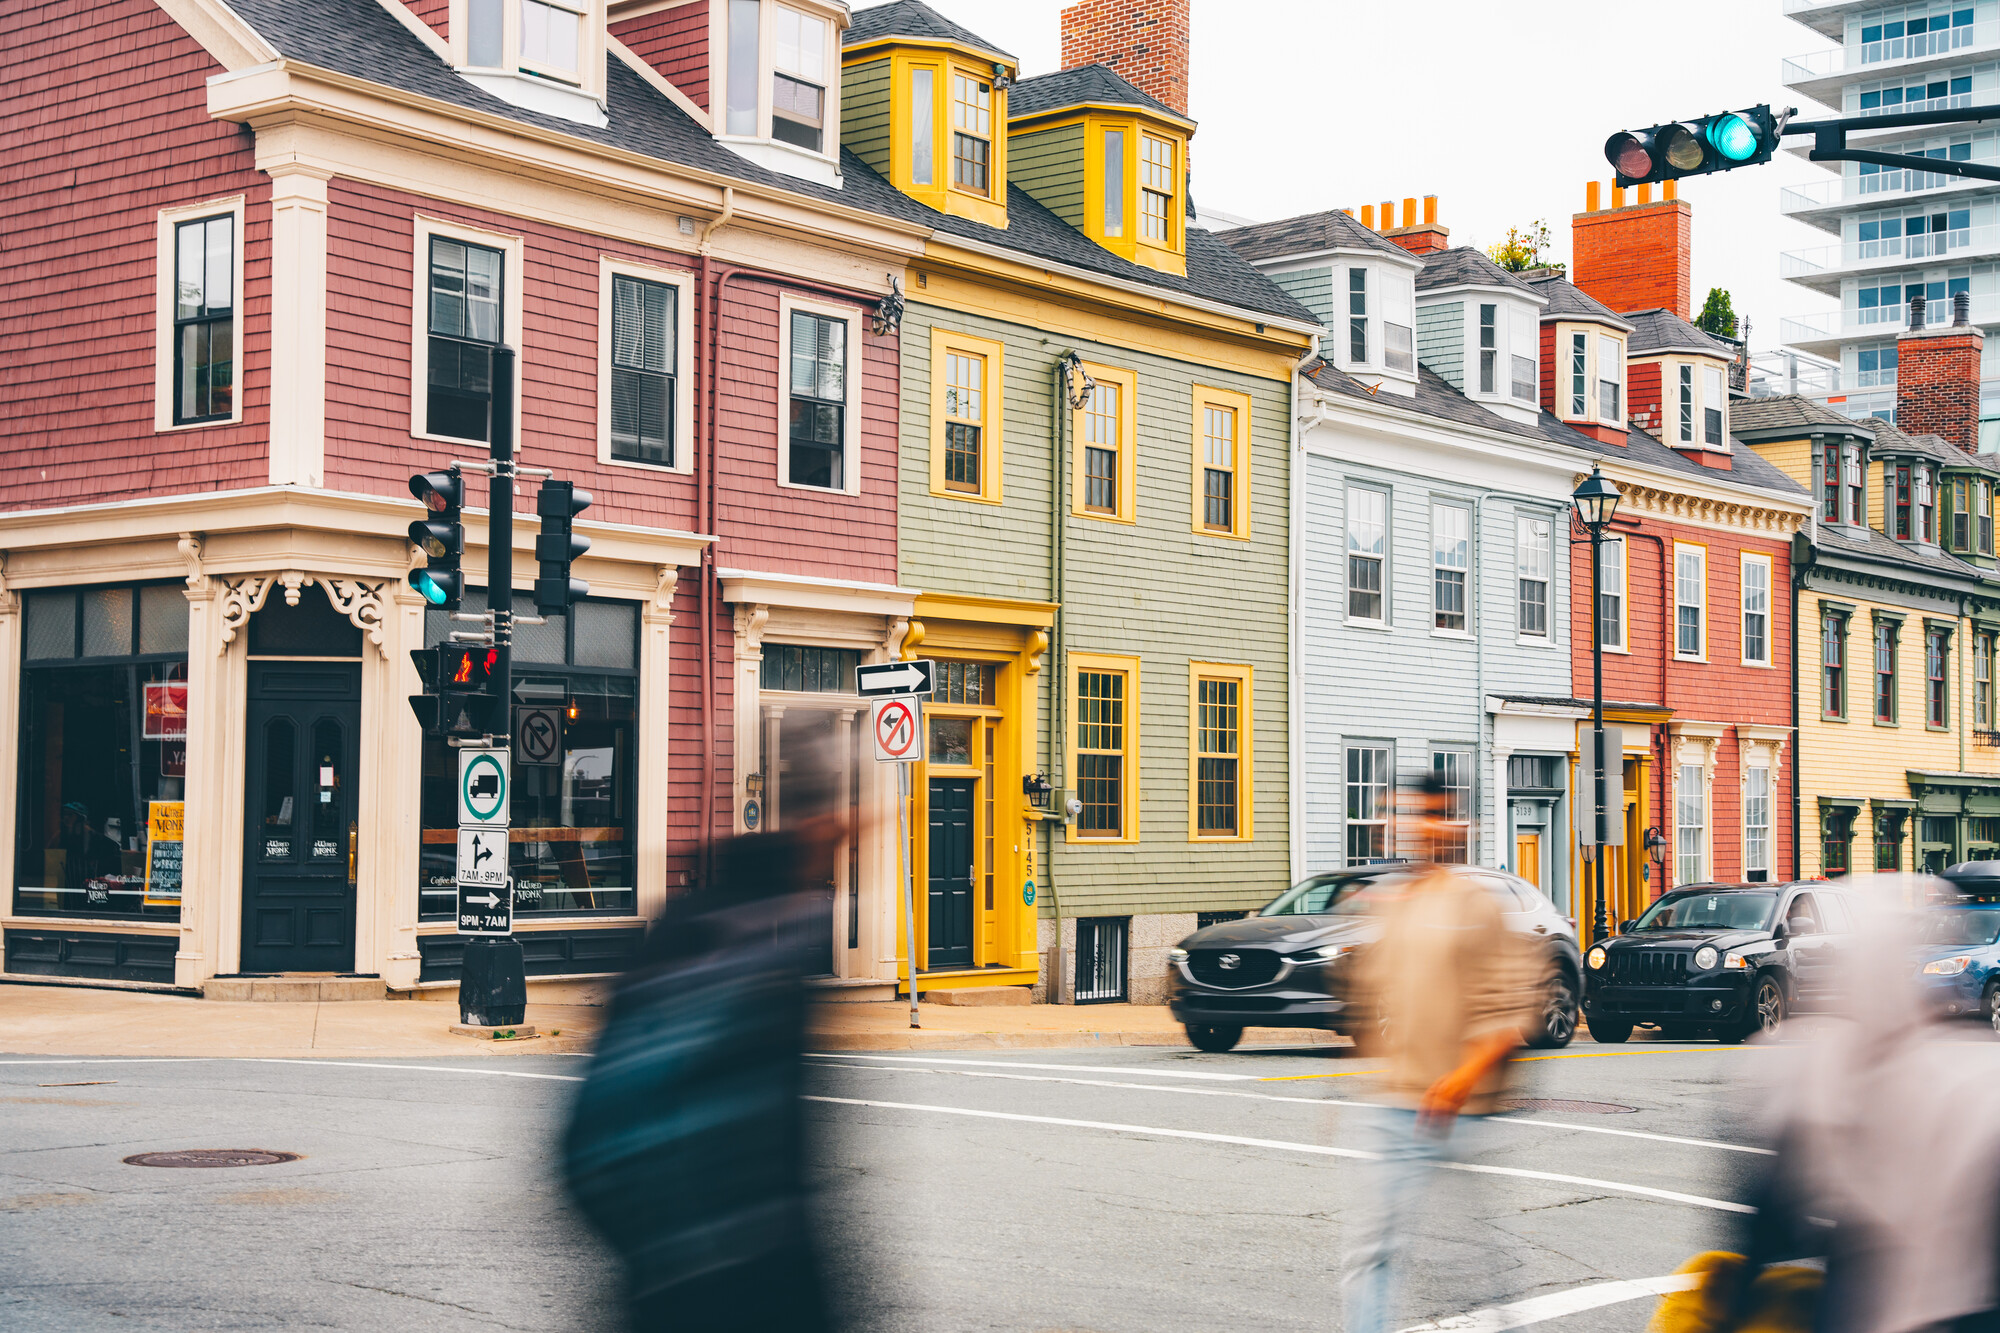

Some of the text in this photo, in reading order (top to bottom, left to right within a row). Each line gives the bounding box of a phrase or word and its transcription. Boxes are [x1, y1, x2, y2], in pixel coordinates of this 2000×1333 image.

[1516, 806, 1531, 816] 5139
[266, 847, 290, 857] MONK
[313, 847, 338, 857] MONK
[461, 869, 478, 881] 7AM
[485, 871, 502, 882] 9PM
[87, 890, 109, 903] MONK
[516, 890, 542, 903] MONK
[461, 915, 478, 926] 9PM
[485, 916, 507, 927] 7AM
